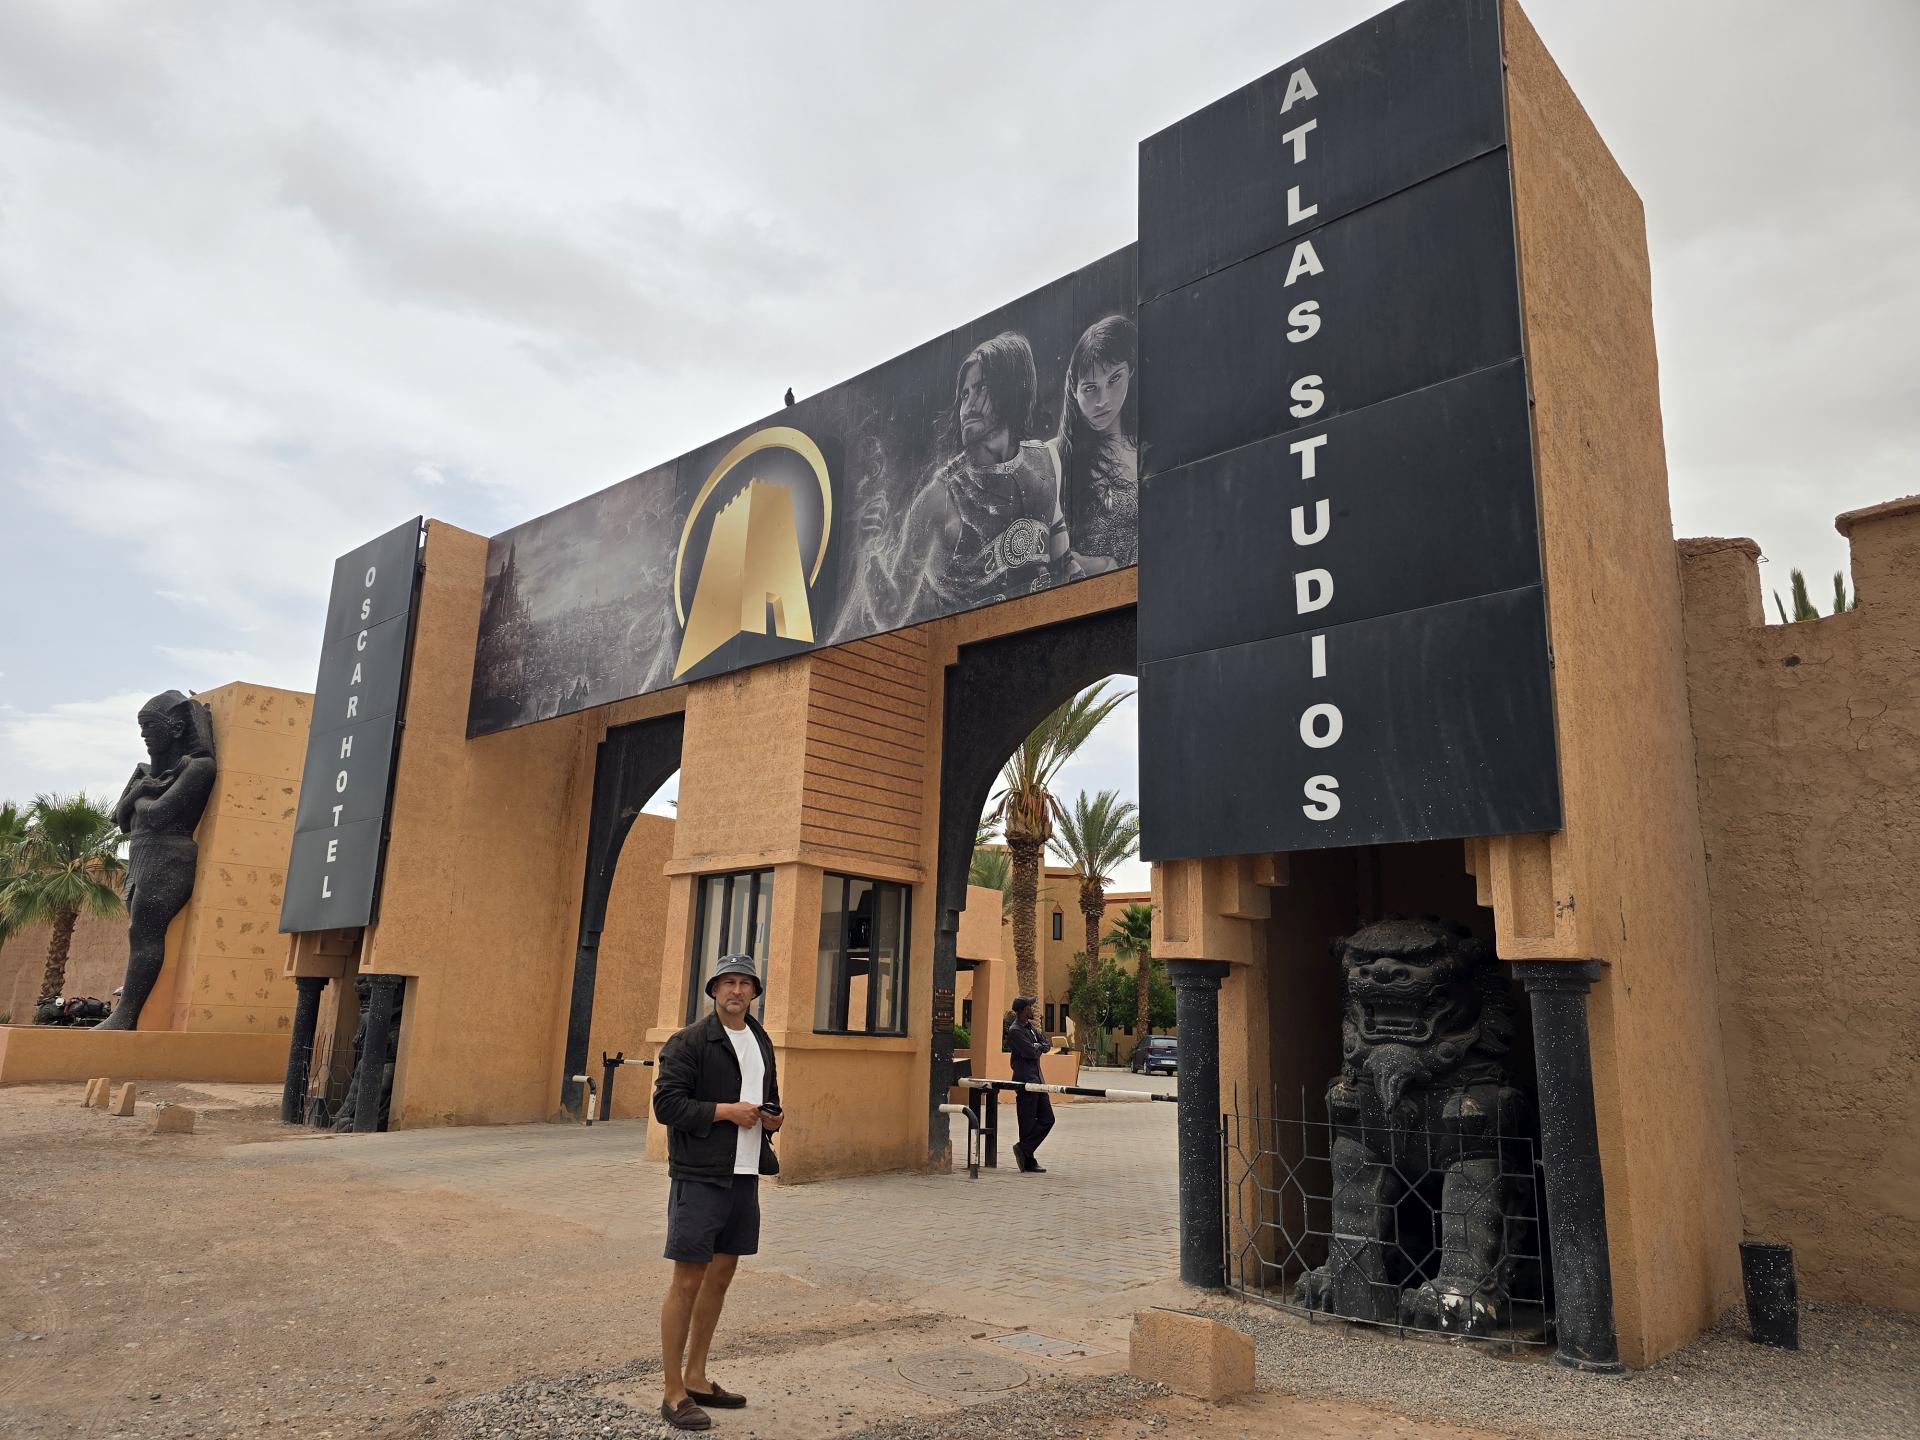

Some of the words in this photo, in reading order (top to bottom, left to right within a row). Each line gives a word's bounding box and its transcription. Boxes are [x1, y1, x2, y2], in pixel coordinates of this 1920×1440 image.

[1279, 67, 1325, 344] ATLAS
[346, 566, 377, 719] OSCAR
[1289, 374, 1343, 821] STUDIOS
[321, 735, 359, 899] HOTEL
